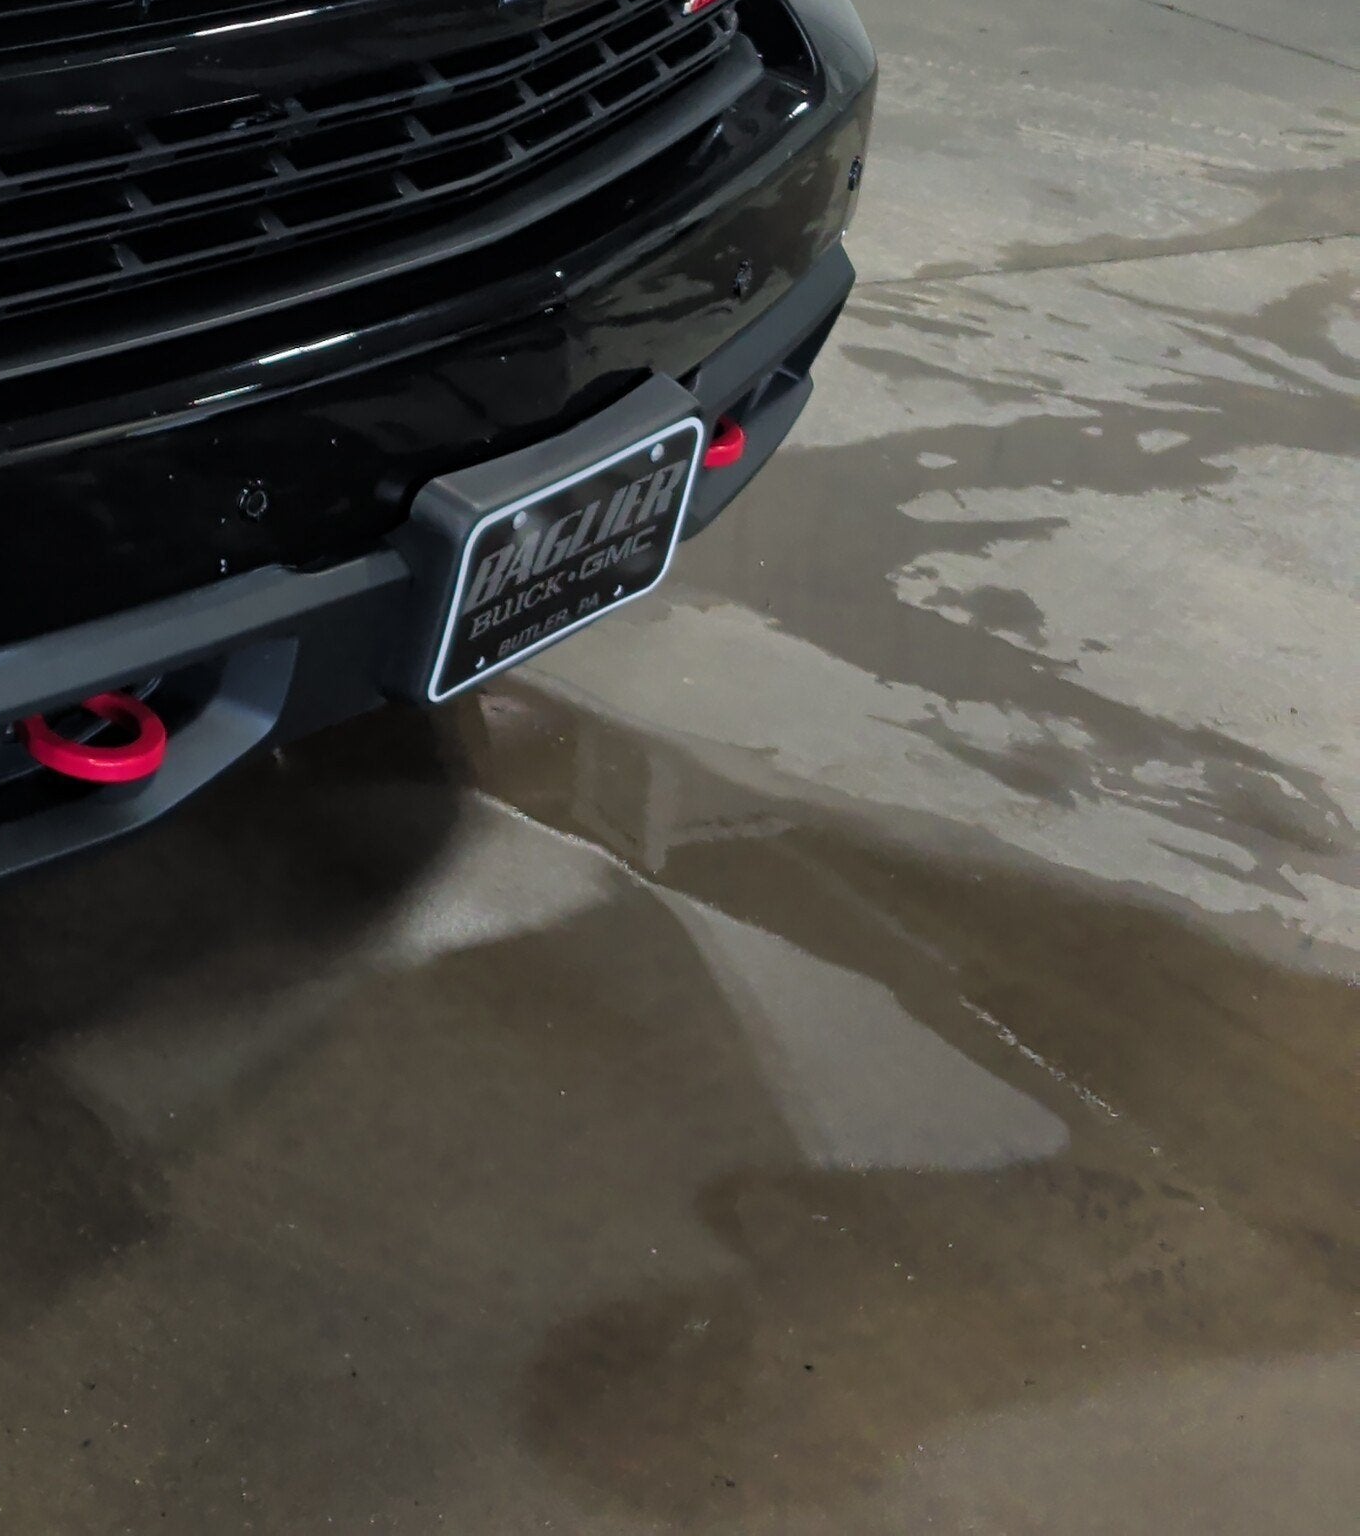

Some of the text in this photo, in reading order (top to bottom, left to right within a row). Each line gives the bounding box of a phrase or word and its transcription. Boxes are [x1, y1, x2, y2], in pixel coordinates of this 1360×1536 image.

[463, 459, 688, 615] BAGLIER
[467, 525, 658, 641] BUICK GMC
[497, 608, 569, 657] BUTLER
